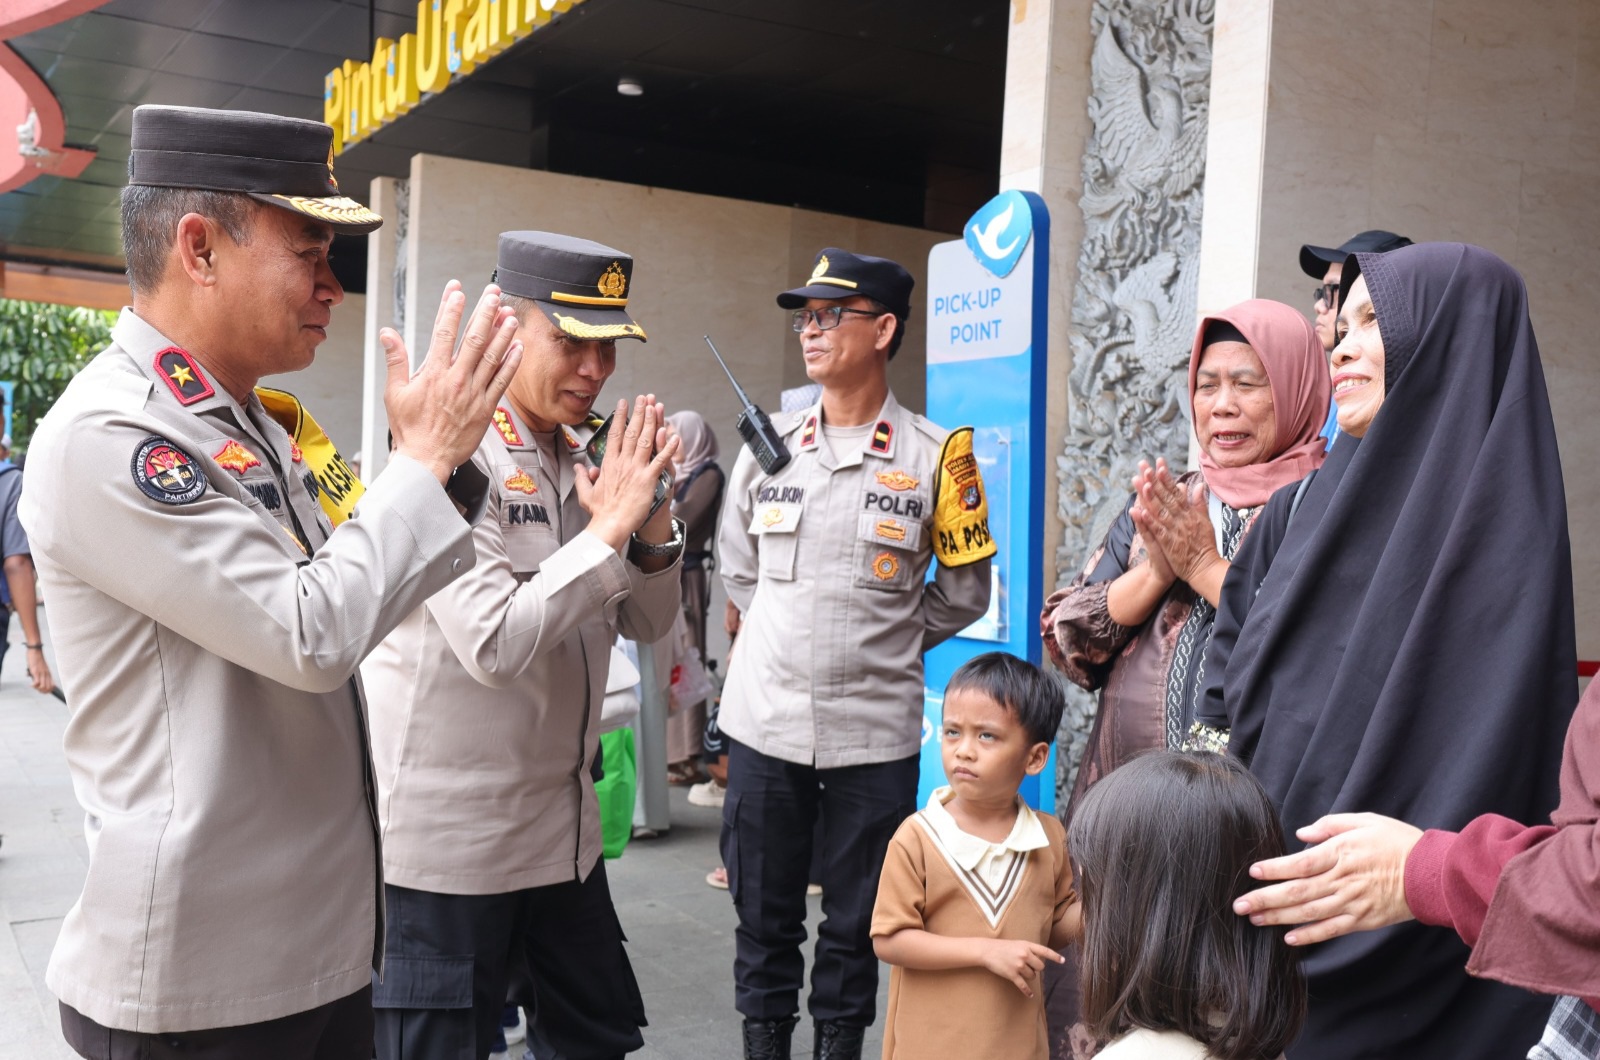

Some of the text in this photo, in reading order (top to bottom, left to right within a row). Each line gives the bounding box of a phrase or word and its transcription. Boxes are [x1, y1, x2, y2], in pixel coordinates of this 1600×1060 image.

[324, 0, 572, 156] Pintu Utam
[934, 287, 1002, 316] PICK-UP
[950, 319, 1002, 345] POINT
[864, 491, 923, 519] POLRI
[938, 530, 960, 556] PA
